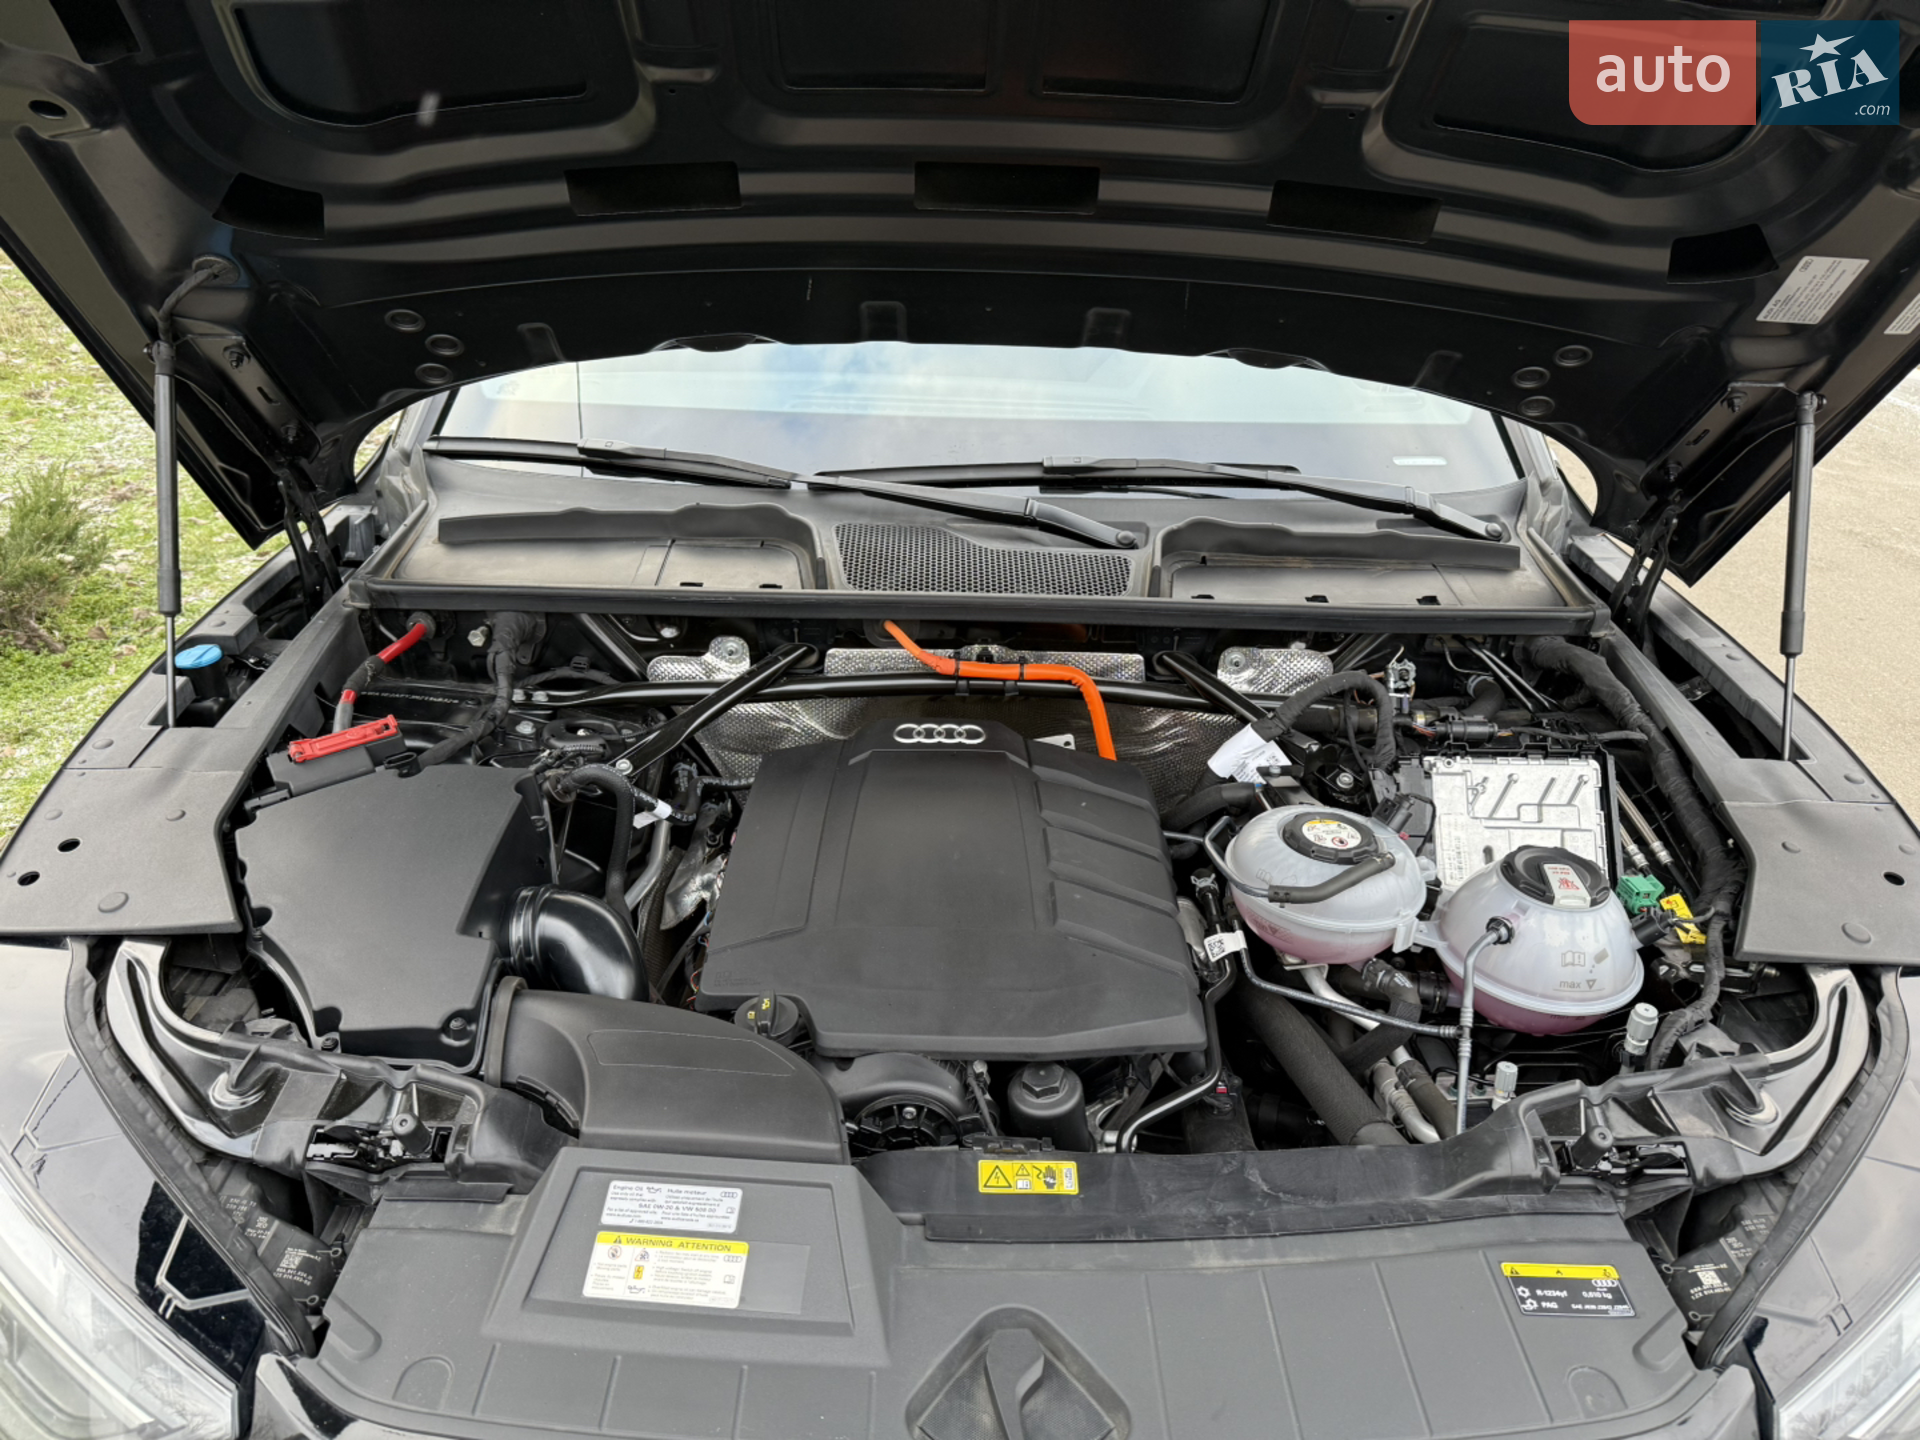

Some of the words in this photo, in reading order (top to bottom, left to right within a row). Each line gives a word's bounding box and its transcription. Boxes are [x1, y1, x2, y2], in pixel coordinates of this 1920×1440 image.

[1559, 980, 1581, 989] max
[626, 1237, 673, 1248] WARNING
[678, 1242, 731, 1252] ATTENTION
[1602, 1291, 1613, 1299] kg
